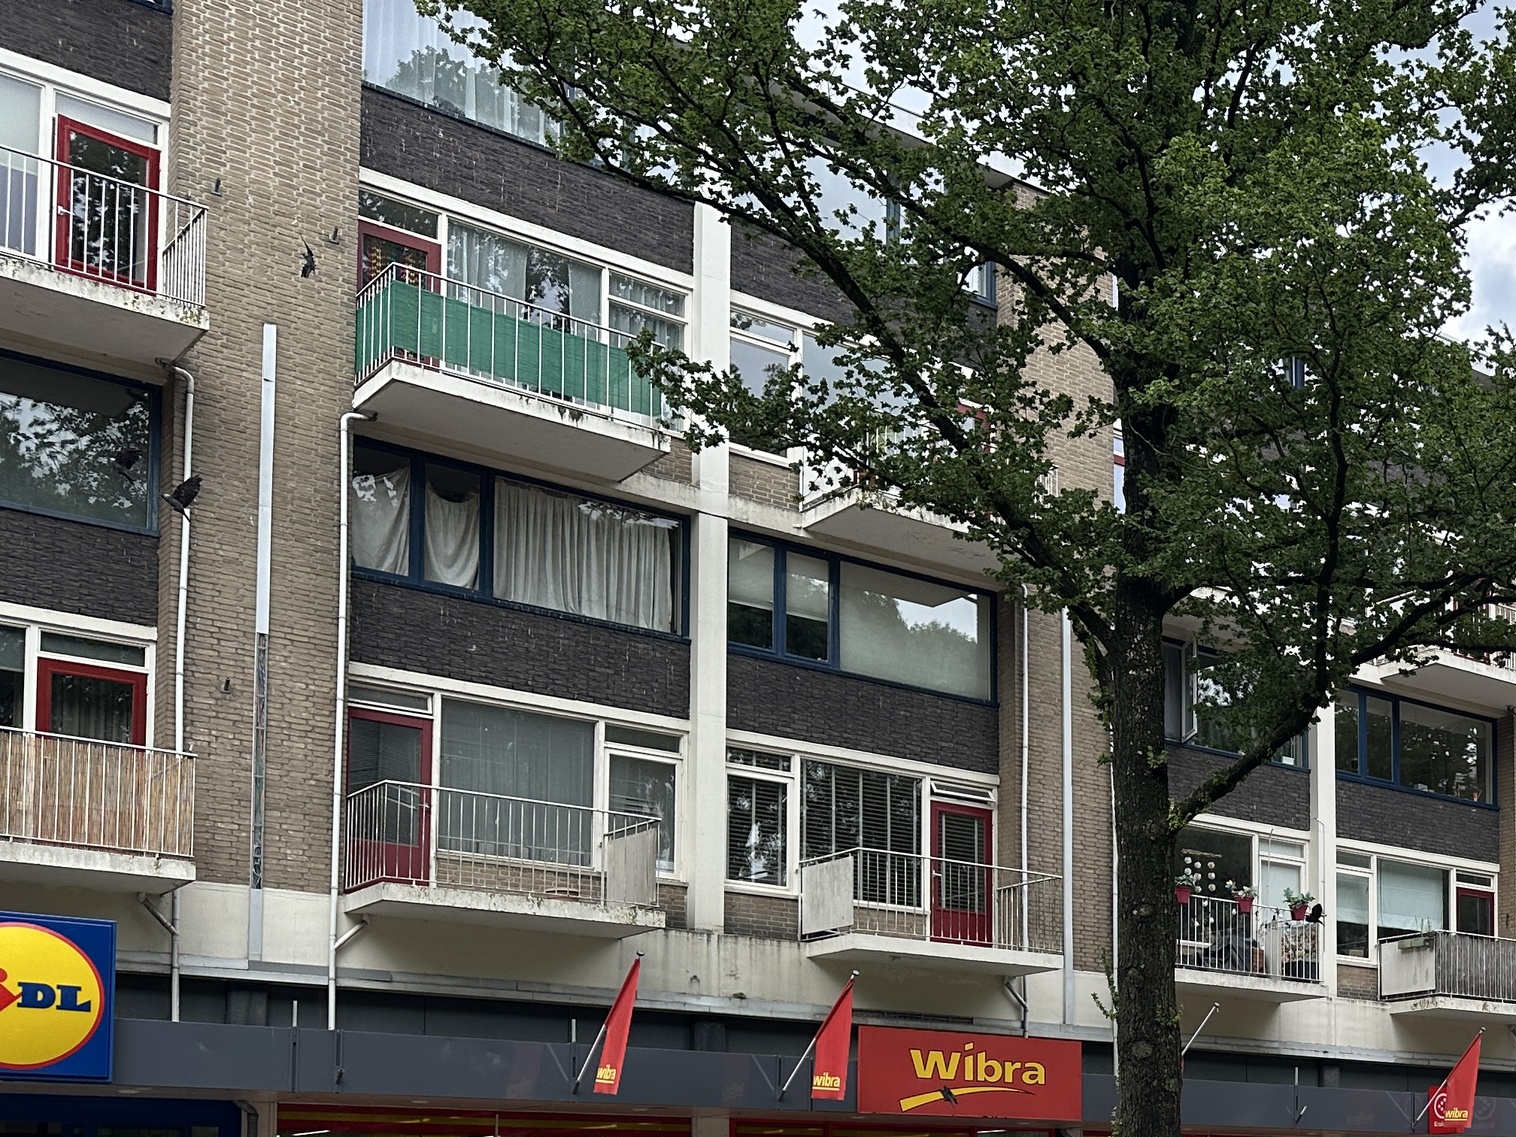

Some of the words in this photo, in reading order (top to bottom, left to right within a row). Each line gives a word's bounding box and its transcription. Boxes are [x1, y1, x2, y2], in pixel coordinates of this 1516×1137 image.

[813, 1071, 841, 1088] wibra
[1445, 1107, 1469, 1118] wibra
[1433, 1119, 1445, 1128] Krui
